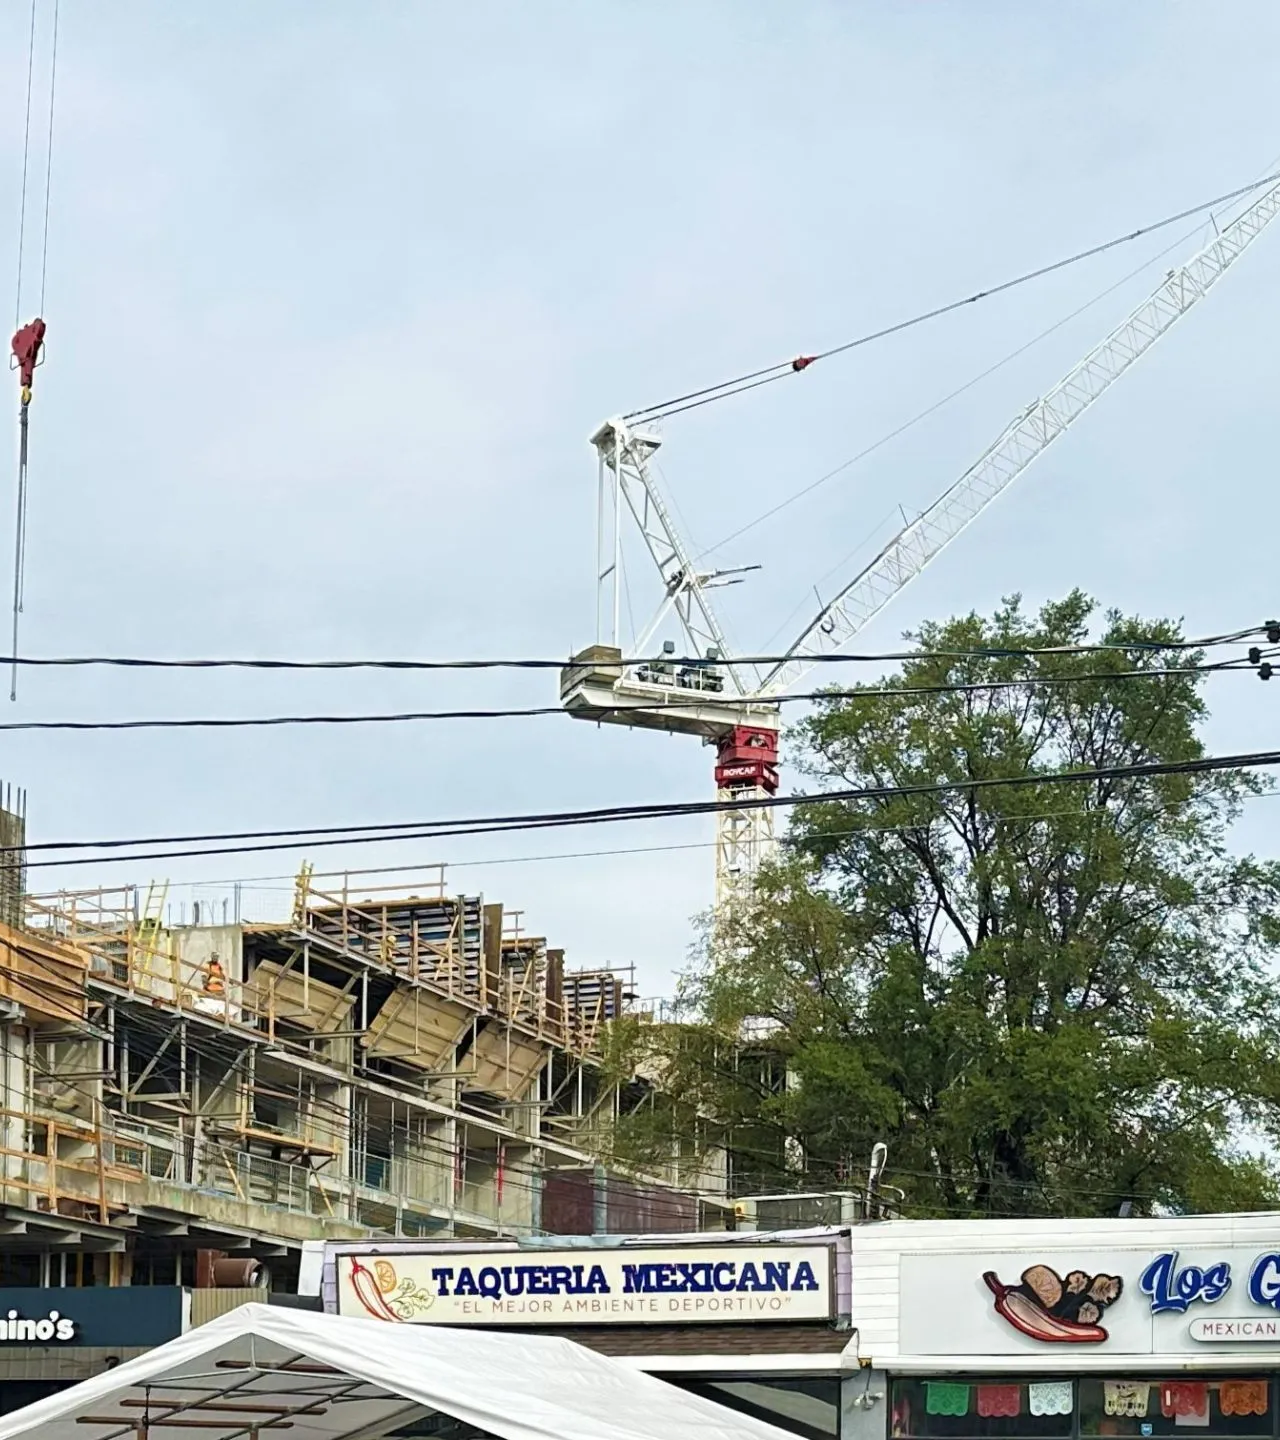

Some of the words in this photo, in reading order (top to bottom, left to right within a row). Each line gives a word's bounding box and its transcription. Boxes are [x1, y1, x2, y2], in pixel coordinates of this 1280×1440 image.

[723, 766, 756, 777] ROYCAP
[432, 1265, 611, 1300] TAQUERIA
[621, 1261, 819, 1293] MEXICANA
[1138, 1251, 1232, 1314] Los
[492, 1300, 553, 1313] MEJOR
[563, 1298, 658, 1312] AMBIENTE
[1203, 1322, 1276, 1335] MEXICAN
